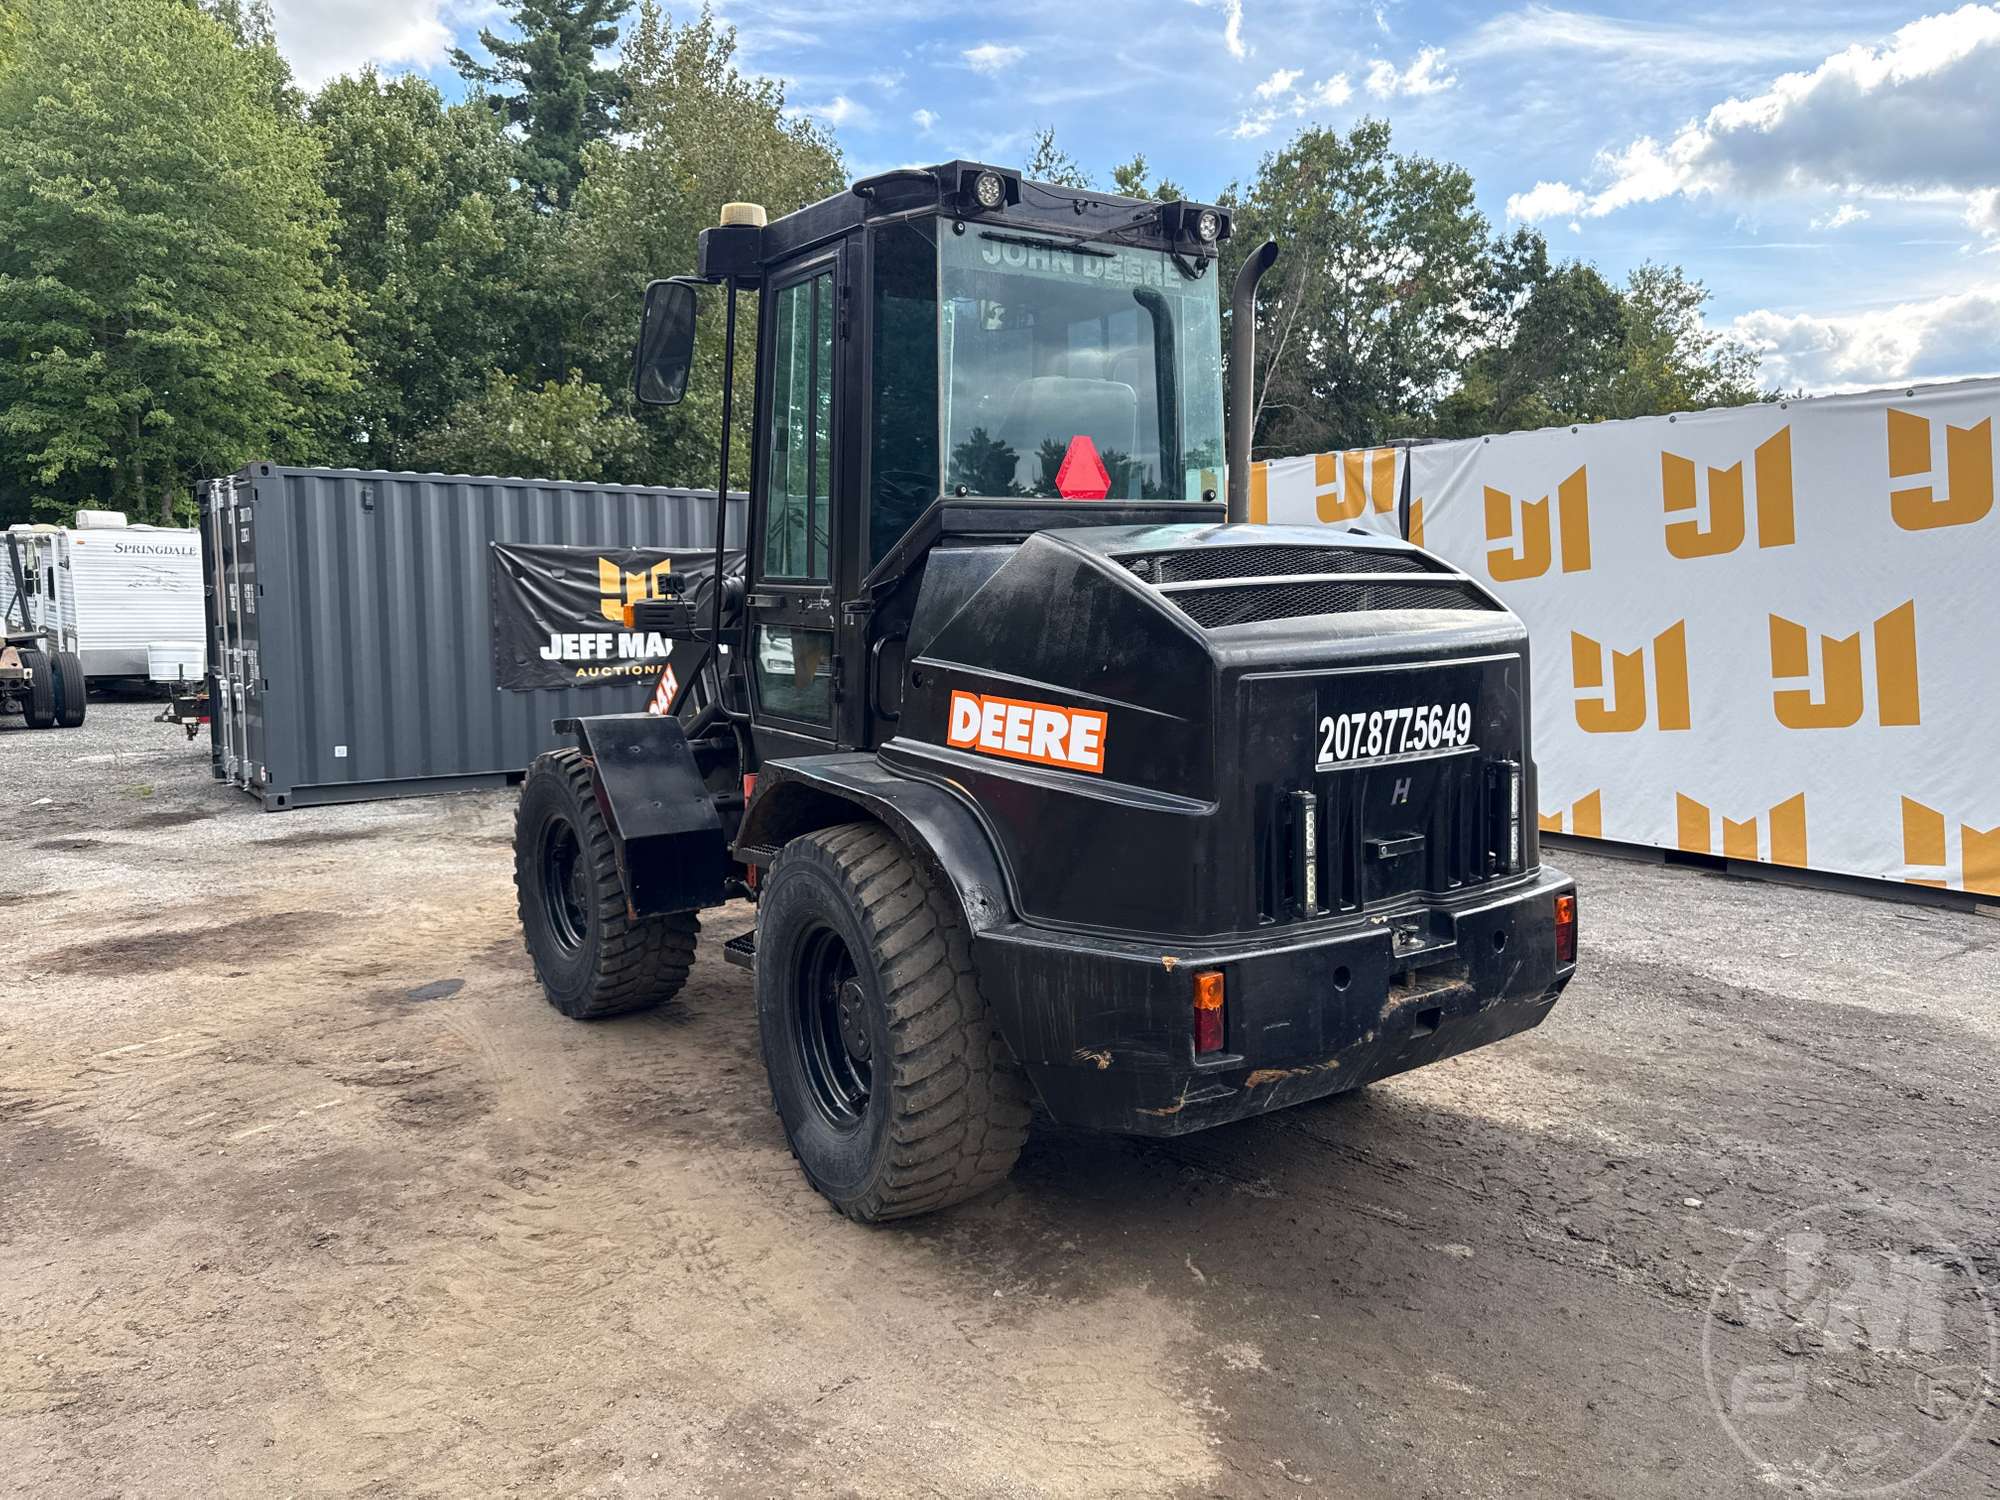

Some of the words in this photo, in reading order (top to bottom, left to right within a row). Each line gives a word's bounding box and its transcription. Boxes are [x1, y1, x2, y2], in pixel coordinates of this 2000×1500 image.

[981, 241, 1074, 275] JOHN
[1082, 253, 1182, 288] DEERE
[113, 542, 198, 557] SPRINGDALE
[541, 634, 613, 660] JEFF
[950, 695, 1103, 767] DEERE
[1318, 703, 1471, 763] 207.877.5649
